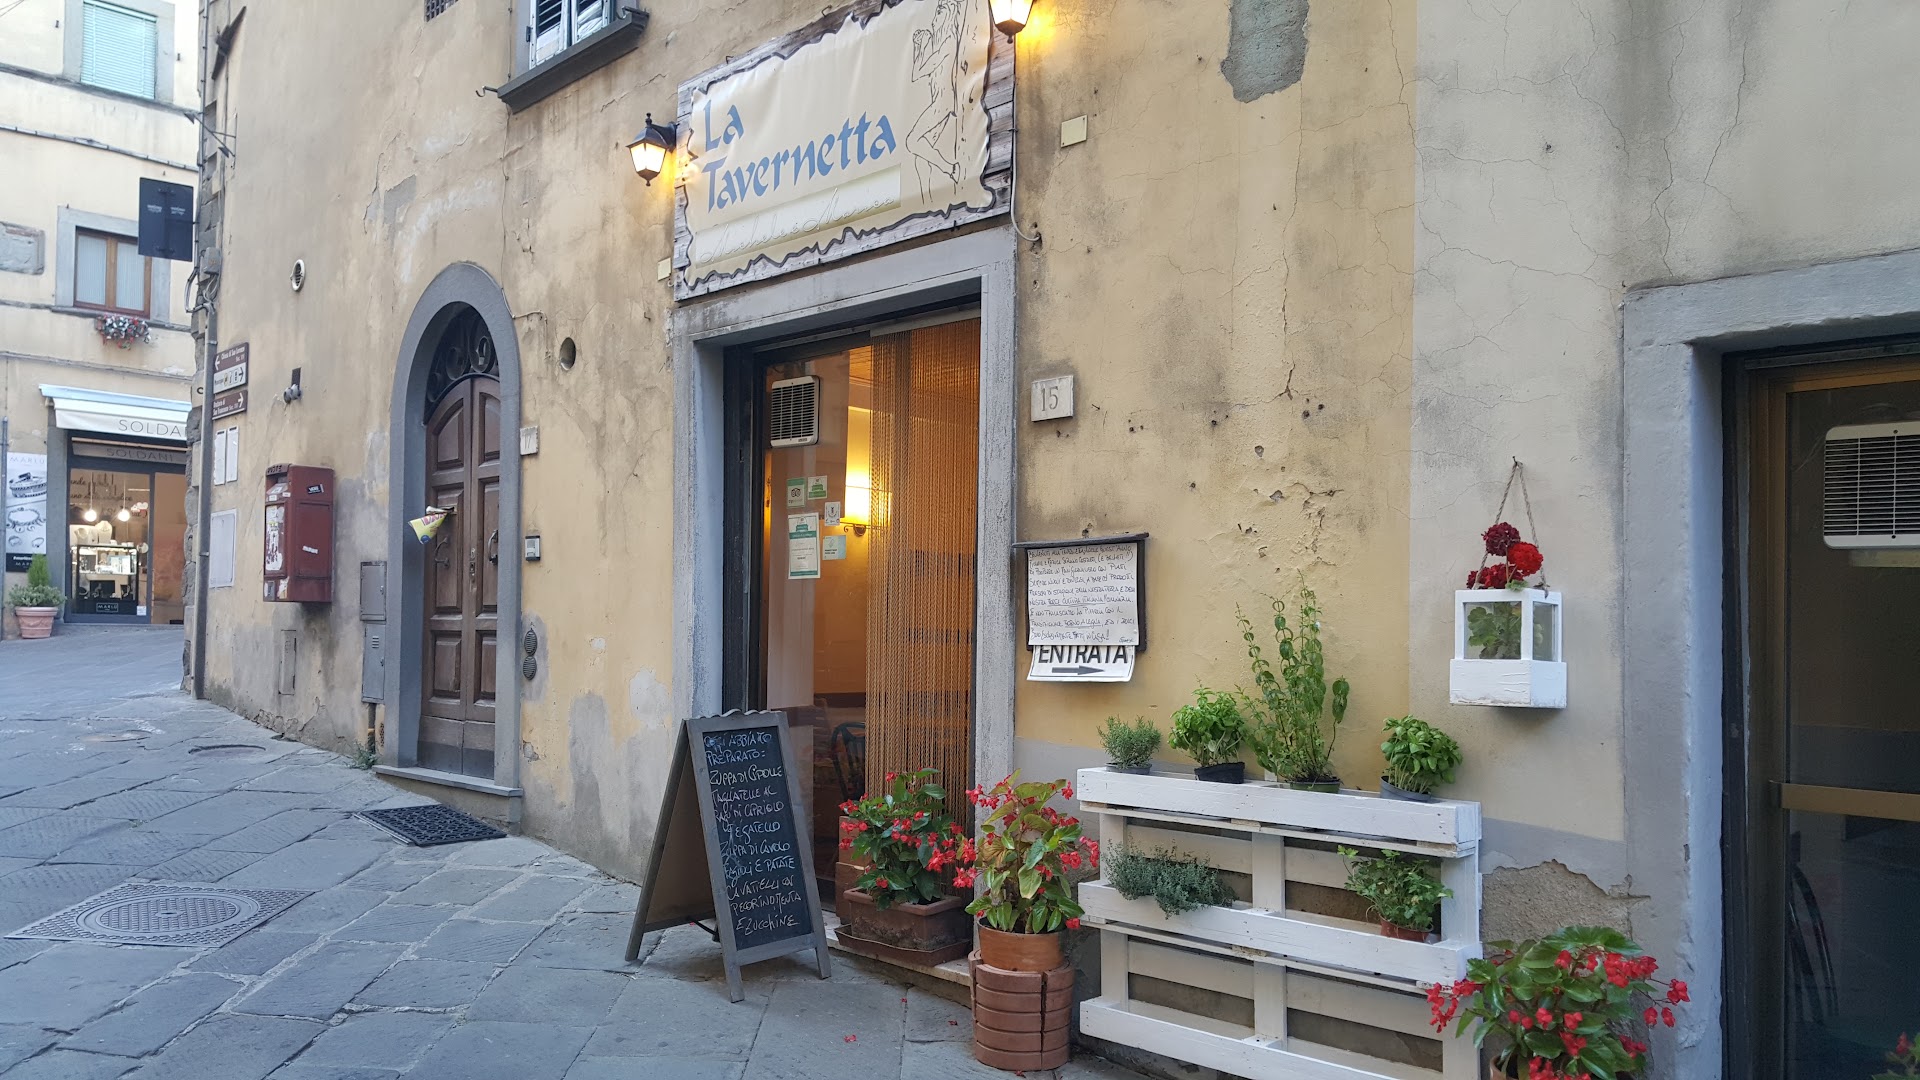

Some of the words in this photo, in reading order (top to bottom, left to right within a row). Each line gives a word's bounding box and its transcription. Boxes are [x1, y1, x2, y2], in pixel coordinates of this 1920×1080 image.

[703, 100, 745, 152] La
[701, 111, 897, 214] Tavernetta
[1039, 386, 1060, 412] 15
[118, 419, 187, 437] SOLDA
[107, 447, 173, 462] SOLDANI
[1038, 645, 1128, 663] ENTRATA
